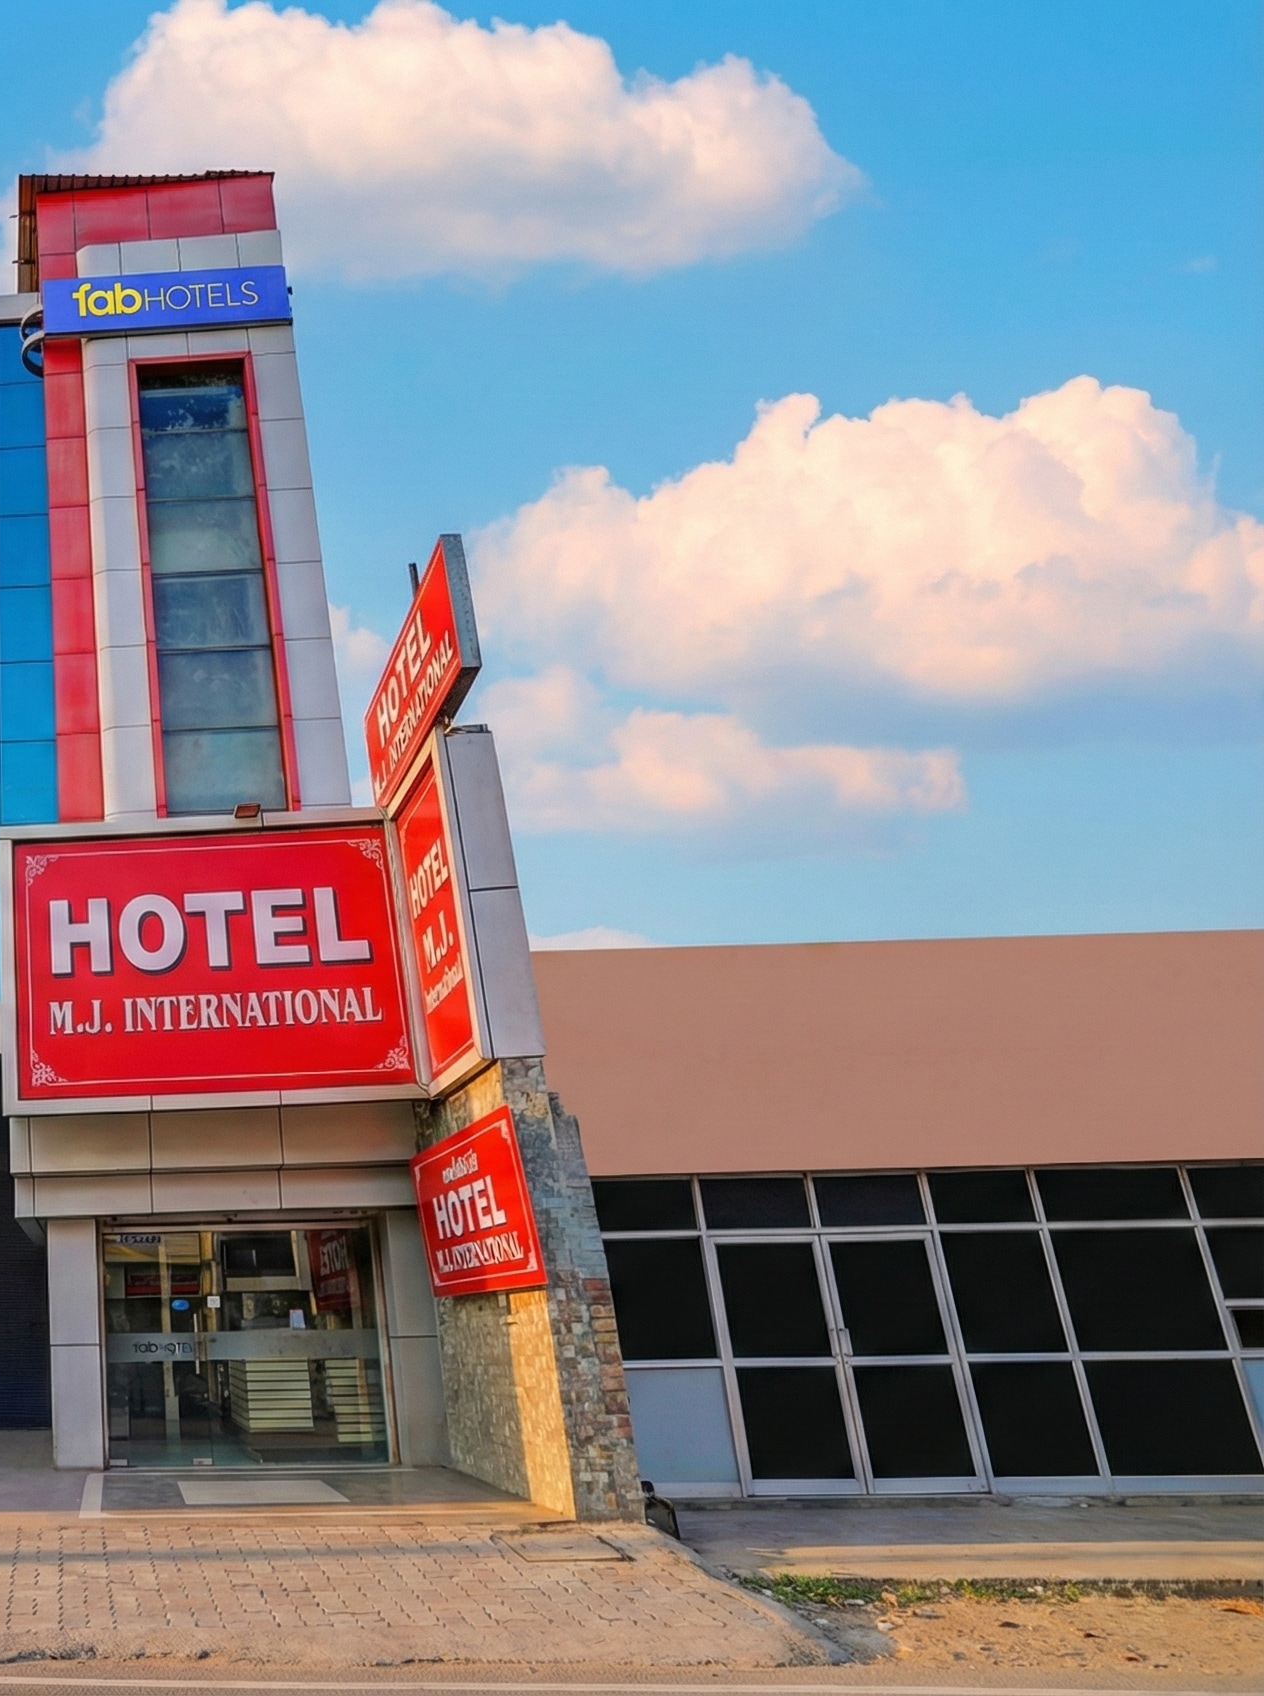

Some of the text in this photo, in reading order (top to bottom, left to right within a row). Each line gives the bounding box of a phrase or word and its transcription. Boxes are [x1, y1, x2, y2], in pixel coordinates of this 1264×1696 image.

[376, 609, 433, 748] HOTEL
[389, 630, 454, 773] INTERNATIONAL
[409, 837, 450, 920] HOTEL
[48, 887, 372, 976] HOTEL
[422, 909, 454, 974] M.J.
[49, 986, 383, 1035] M.J. INTERNATIONAL
[433, 1174, 507, 1240] HOTEL
